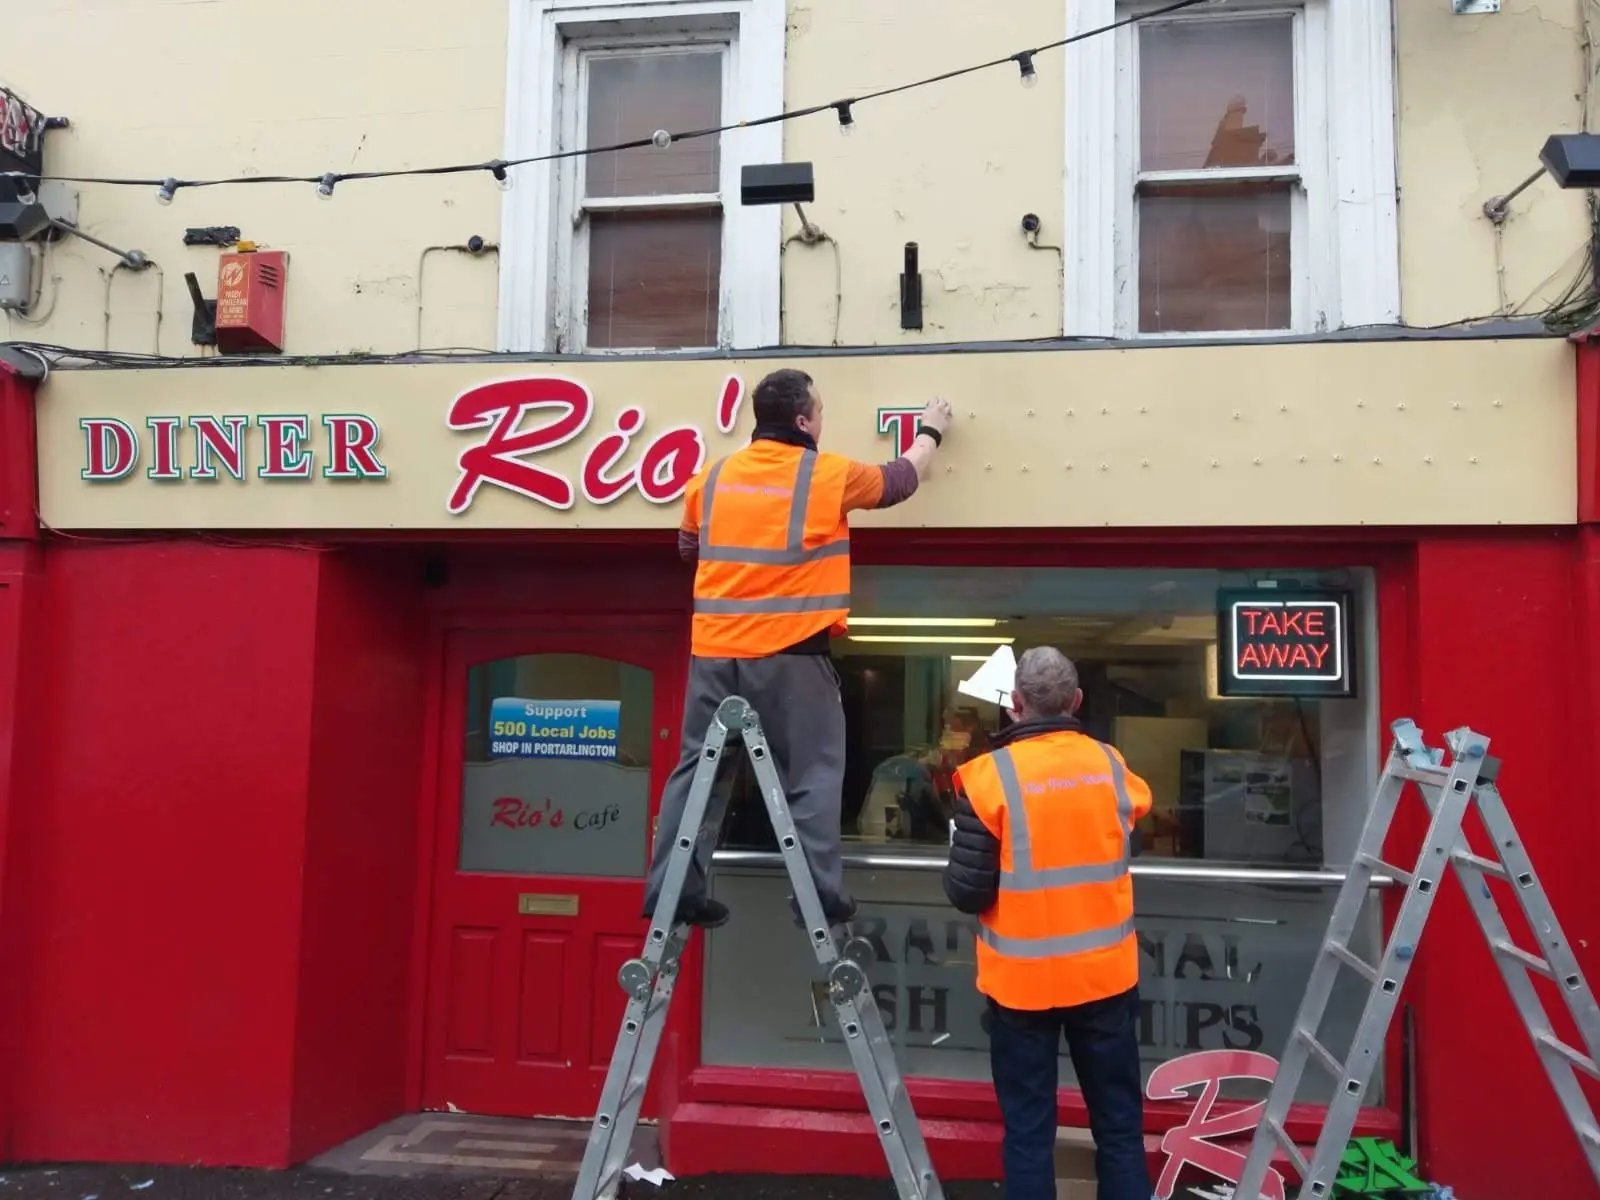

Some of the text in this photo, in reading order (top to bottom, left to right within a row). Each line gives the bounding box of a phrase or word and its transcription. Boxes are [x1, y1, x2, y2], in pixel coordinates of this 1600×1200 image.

[80, 413, 389, 481] DINER
[447, 374, 746, 514] Rio'
[1241, 611, 1325, 636] TAKE
[1239, 643, 1329, 669] AWAY
[525, 704, 588, 720] Support
[494, 721, 617, 740] 500 Local Jobs
[492, 741, 617, 757] SHOP IN PORTARLINGTON
[490, 797, 620, 831] Rio's Café
